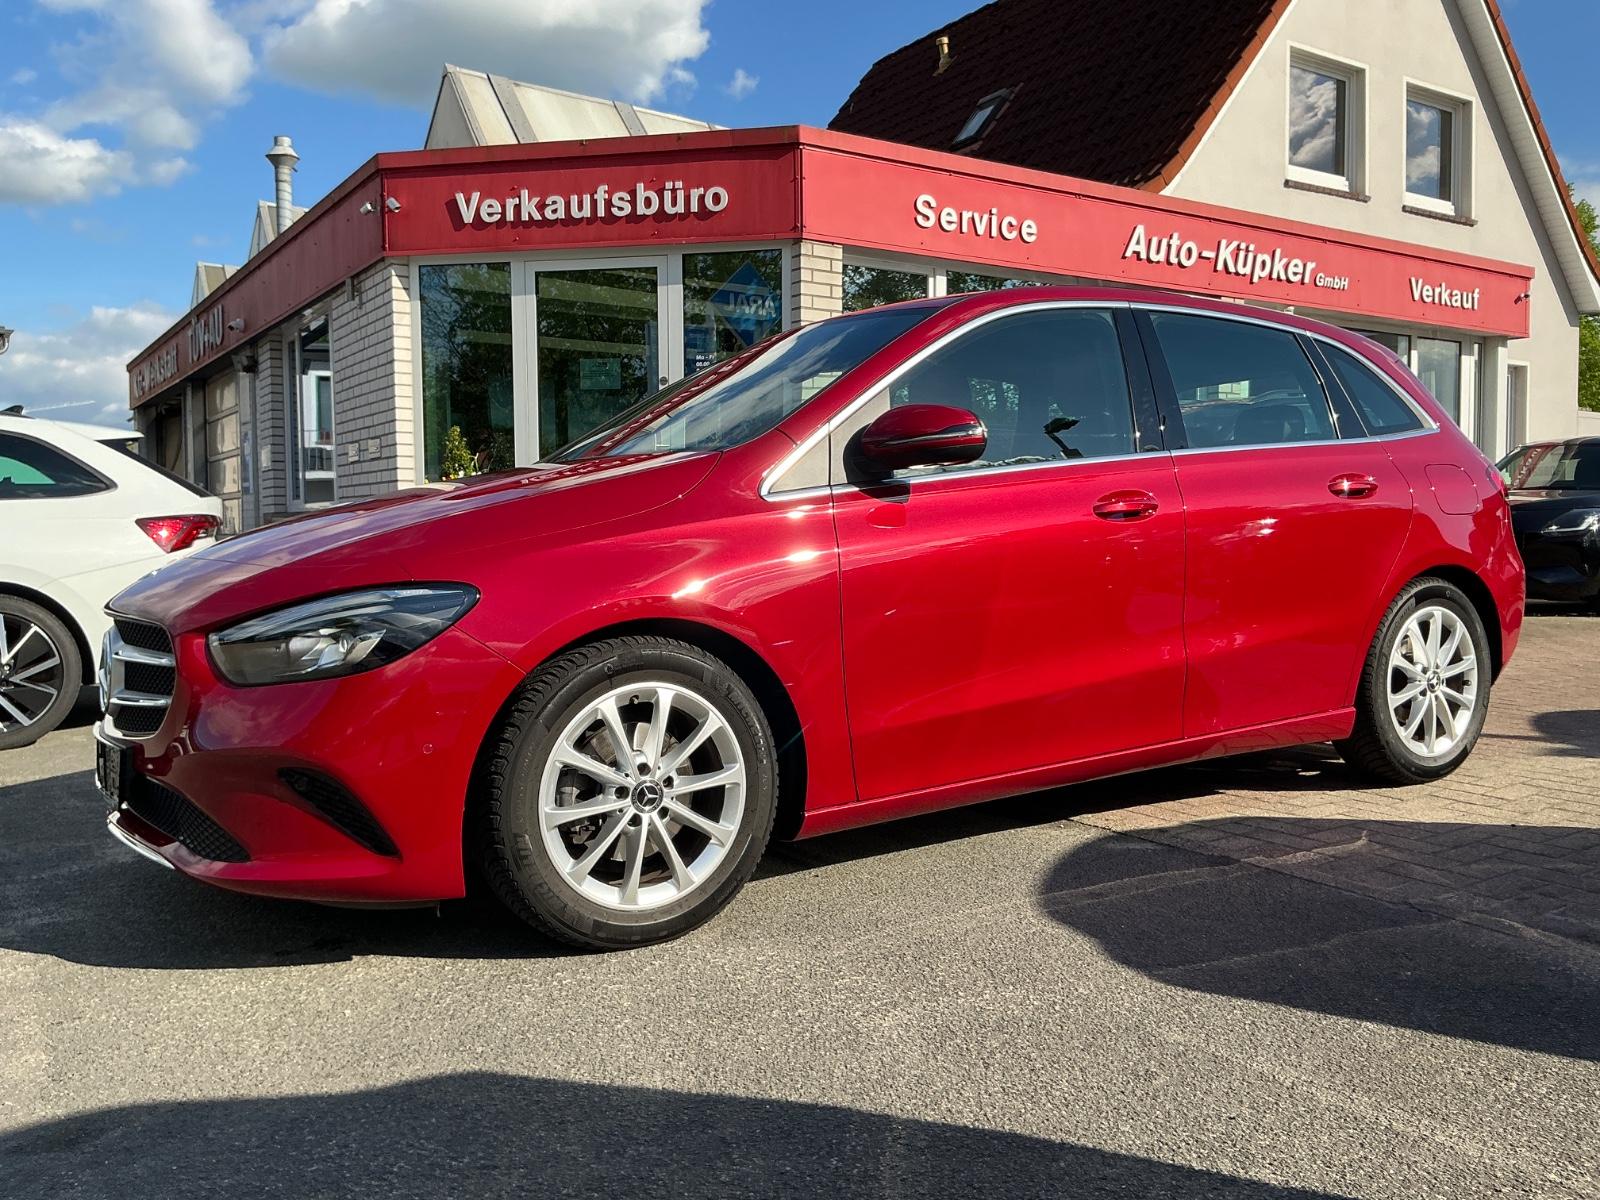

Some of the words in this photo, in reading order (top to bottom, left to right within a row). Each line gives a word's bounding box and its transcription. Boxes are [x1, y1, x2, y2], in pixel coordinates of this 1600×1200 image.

[455, 180, 729, 224] Verkaufsbüro
[914, 193, 1038, 243] Service
[1122, 224, 1316, 284] Auto-Küpker
[1315, 272, 1349, 290] GmbH
[1409, 276, 1480, 310] Verkauf
